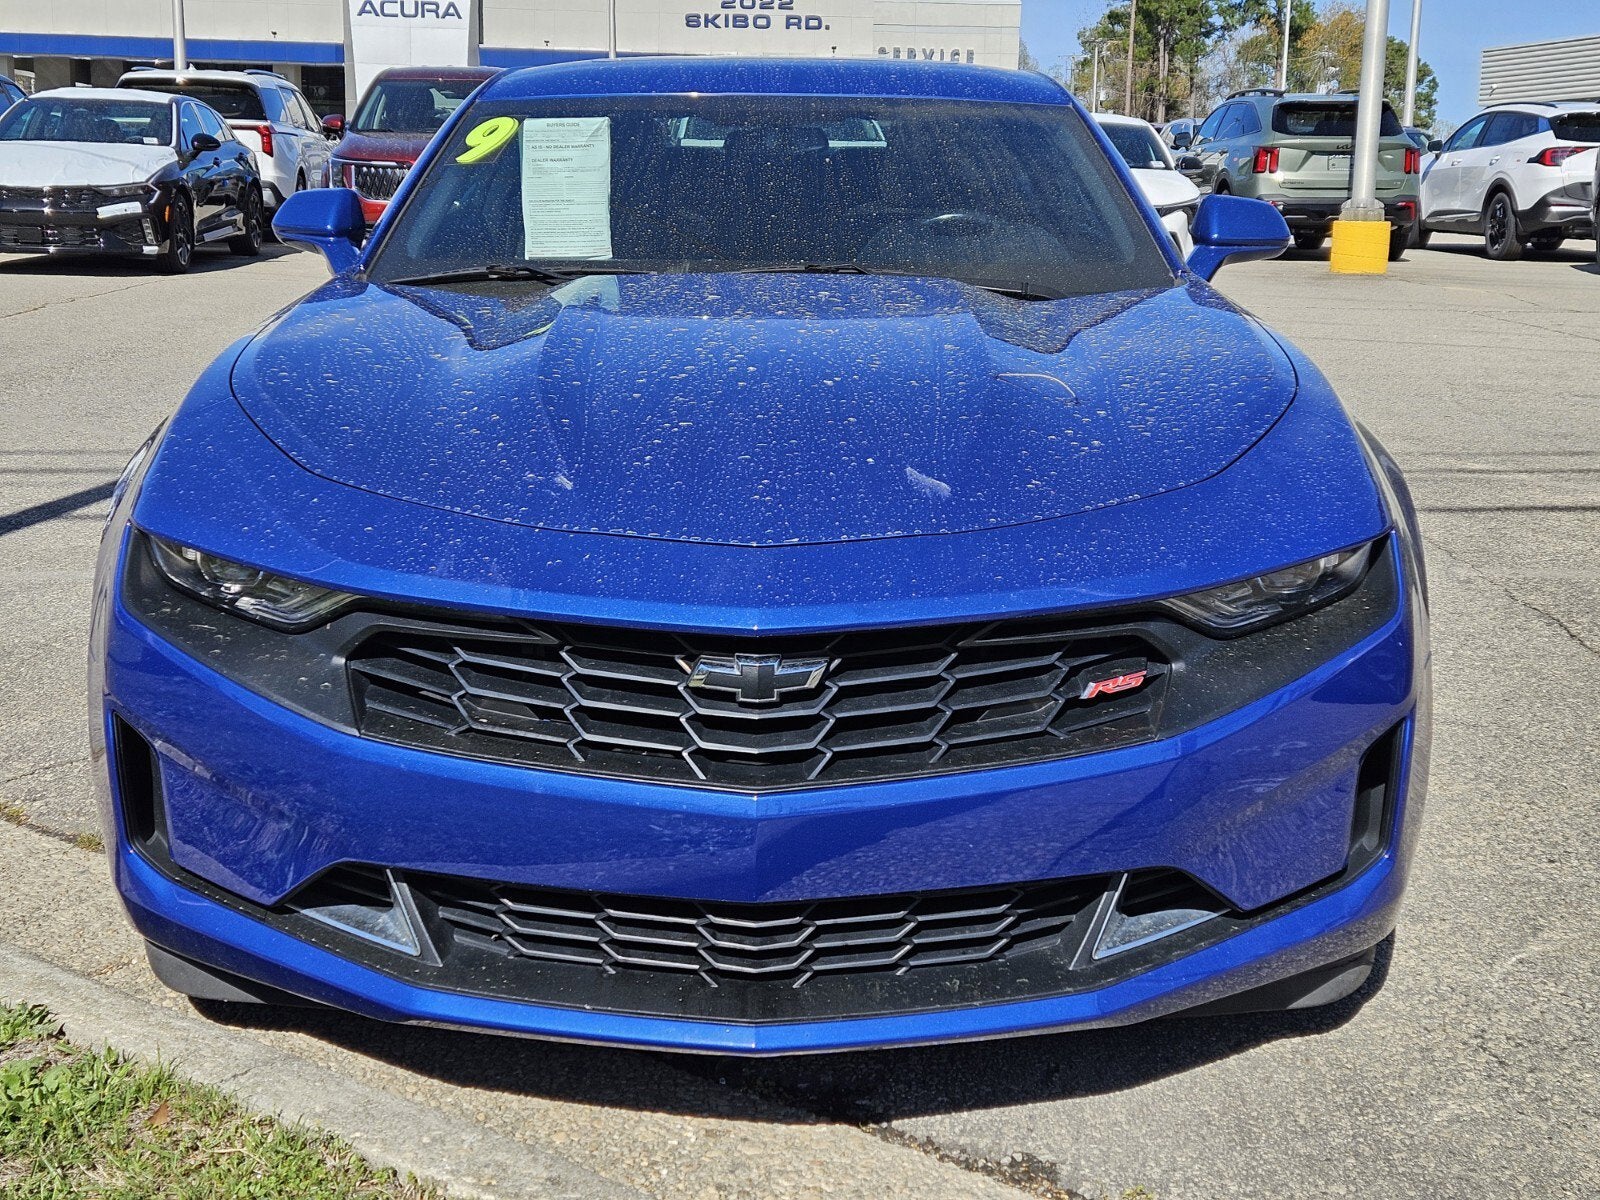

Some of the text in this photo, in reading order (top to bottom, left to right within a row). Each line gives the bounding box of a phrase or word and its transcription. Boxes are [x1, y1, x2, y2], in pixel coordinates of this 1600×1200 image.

[356, 0, 463, 19] ACURA
[720, 0, 794, 10] 2022
[684, 13, 831, 31] SKIBO RD.
[877, 46, 975, 64] SERVICE
[455, 116, 519, 164] 9
[1079, 670, 1147, 699] RS
